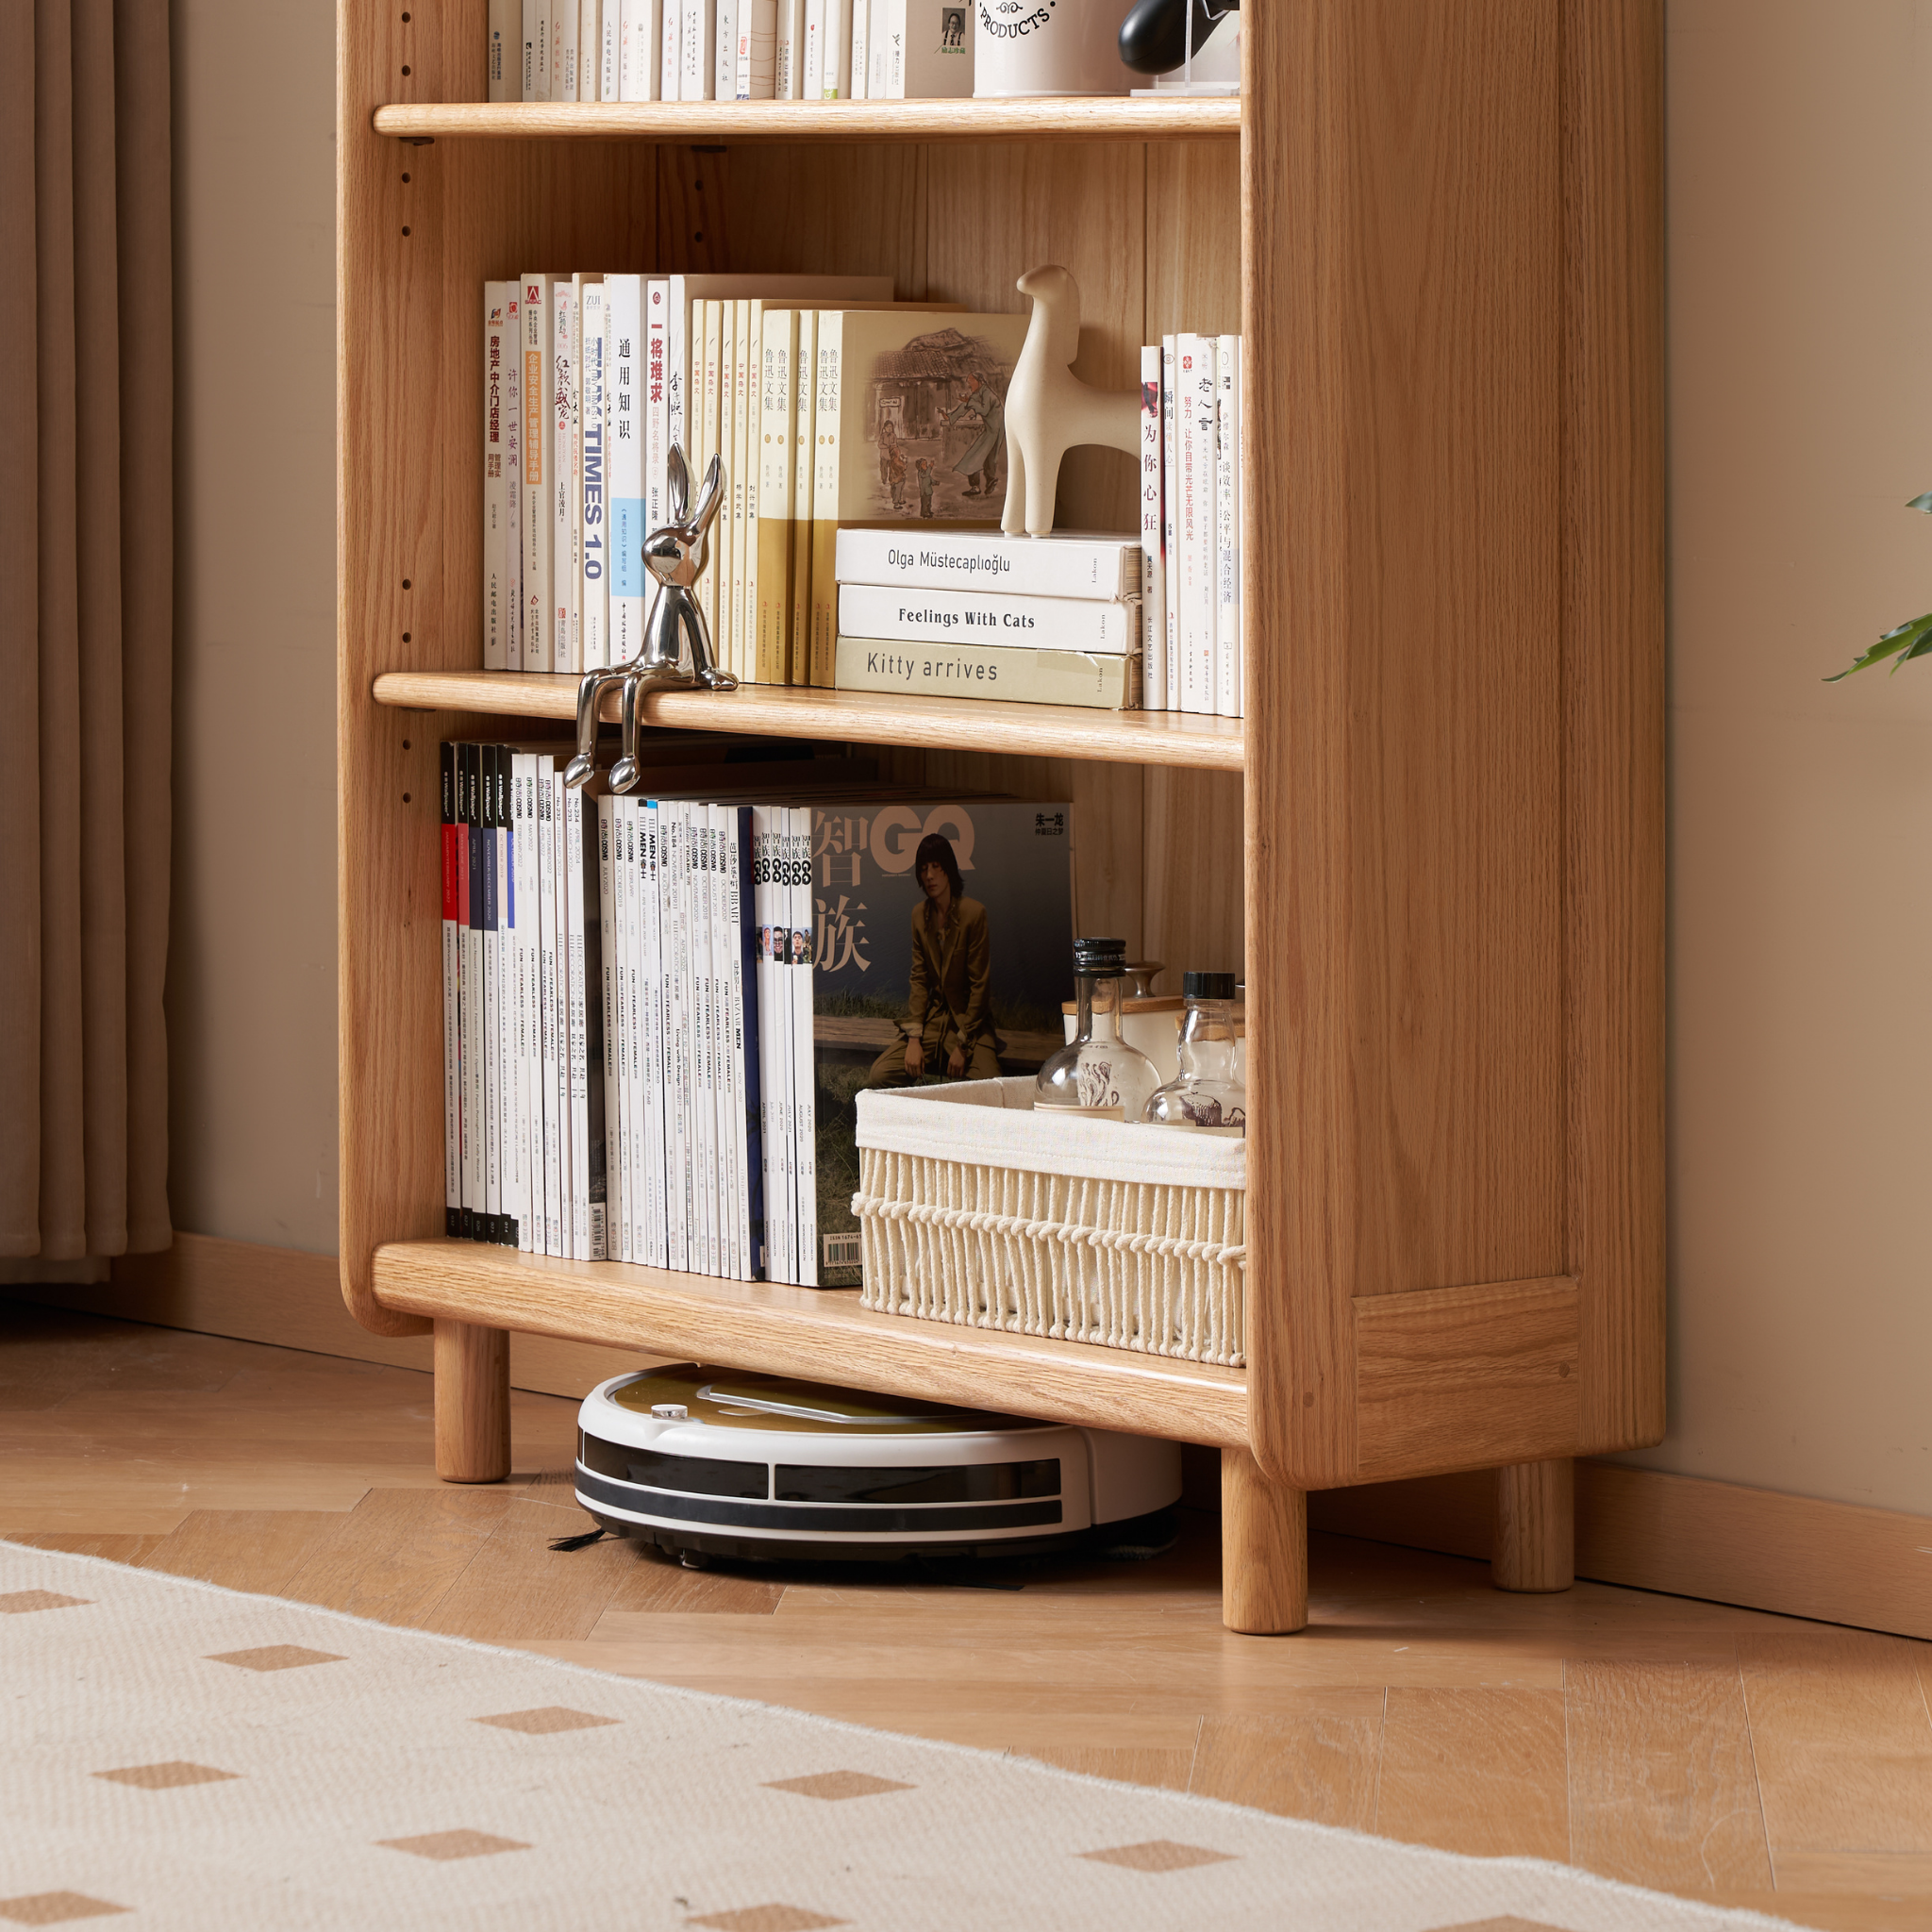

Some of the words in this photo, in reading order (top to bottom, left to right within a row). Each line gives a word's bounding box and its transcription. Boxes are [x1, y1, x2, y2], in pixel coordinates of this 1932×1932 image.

[979, 8, 1051, 39] PRODUCTS
[586, 295, 601, 305] ZUI
[650, 324, 663, 404] 一将难求
[764, 348, 774, 411] 鲁迅文集
[776, 348, 787, 412] 鲁迅文集
[797, 349, 808, 412] 鲁迅文集
[819, 349, 828, 412] 鲁迅文集
[828, 348, 838, 411] 鲁迅文集
[490, 336, 501, 443] 房地产中介门店经理
[618, 338, 631, 441] 通用知识
[1164, 391, 1174, 420] 瞬间
[1198, 377, 1213, 431] 老人言
[528, 353, 540, 482] 企业安全生产管理辅导手册
[1143, 424, 1158, 530] 为你心狂
[586, 534, 603, 580] 1.0
[887, 549, 914, 570] Olga
[898, 608, 959, 627] Feelings
[964, 611, 997, 626] With
[1003, 613, 1036, 628] Cats
[867, 652, 915, 681] Kitty
[923, 658, 998, 680] arrives
[1035, 812, 1064, 826] 朱一龙
[1035, 827, 1064, 836] 仲夏日之梦
[870, 804, 975, 874] GQ
[754, 859, 761, 885] GQ
[761, 858, 771, 883] GQ
[772, 858, 781, 883] GQ
[782, 860, 791, 886] GQ
[791, 860, 801, 886] GQ
[801, 859, 811, 885] GQ
[812, 808, 871, 974] 智族
